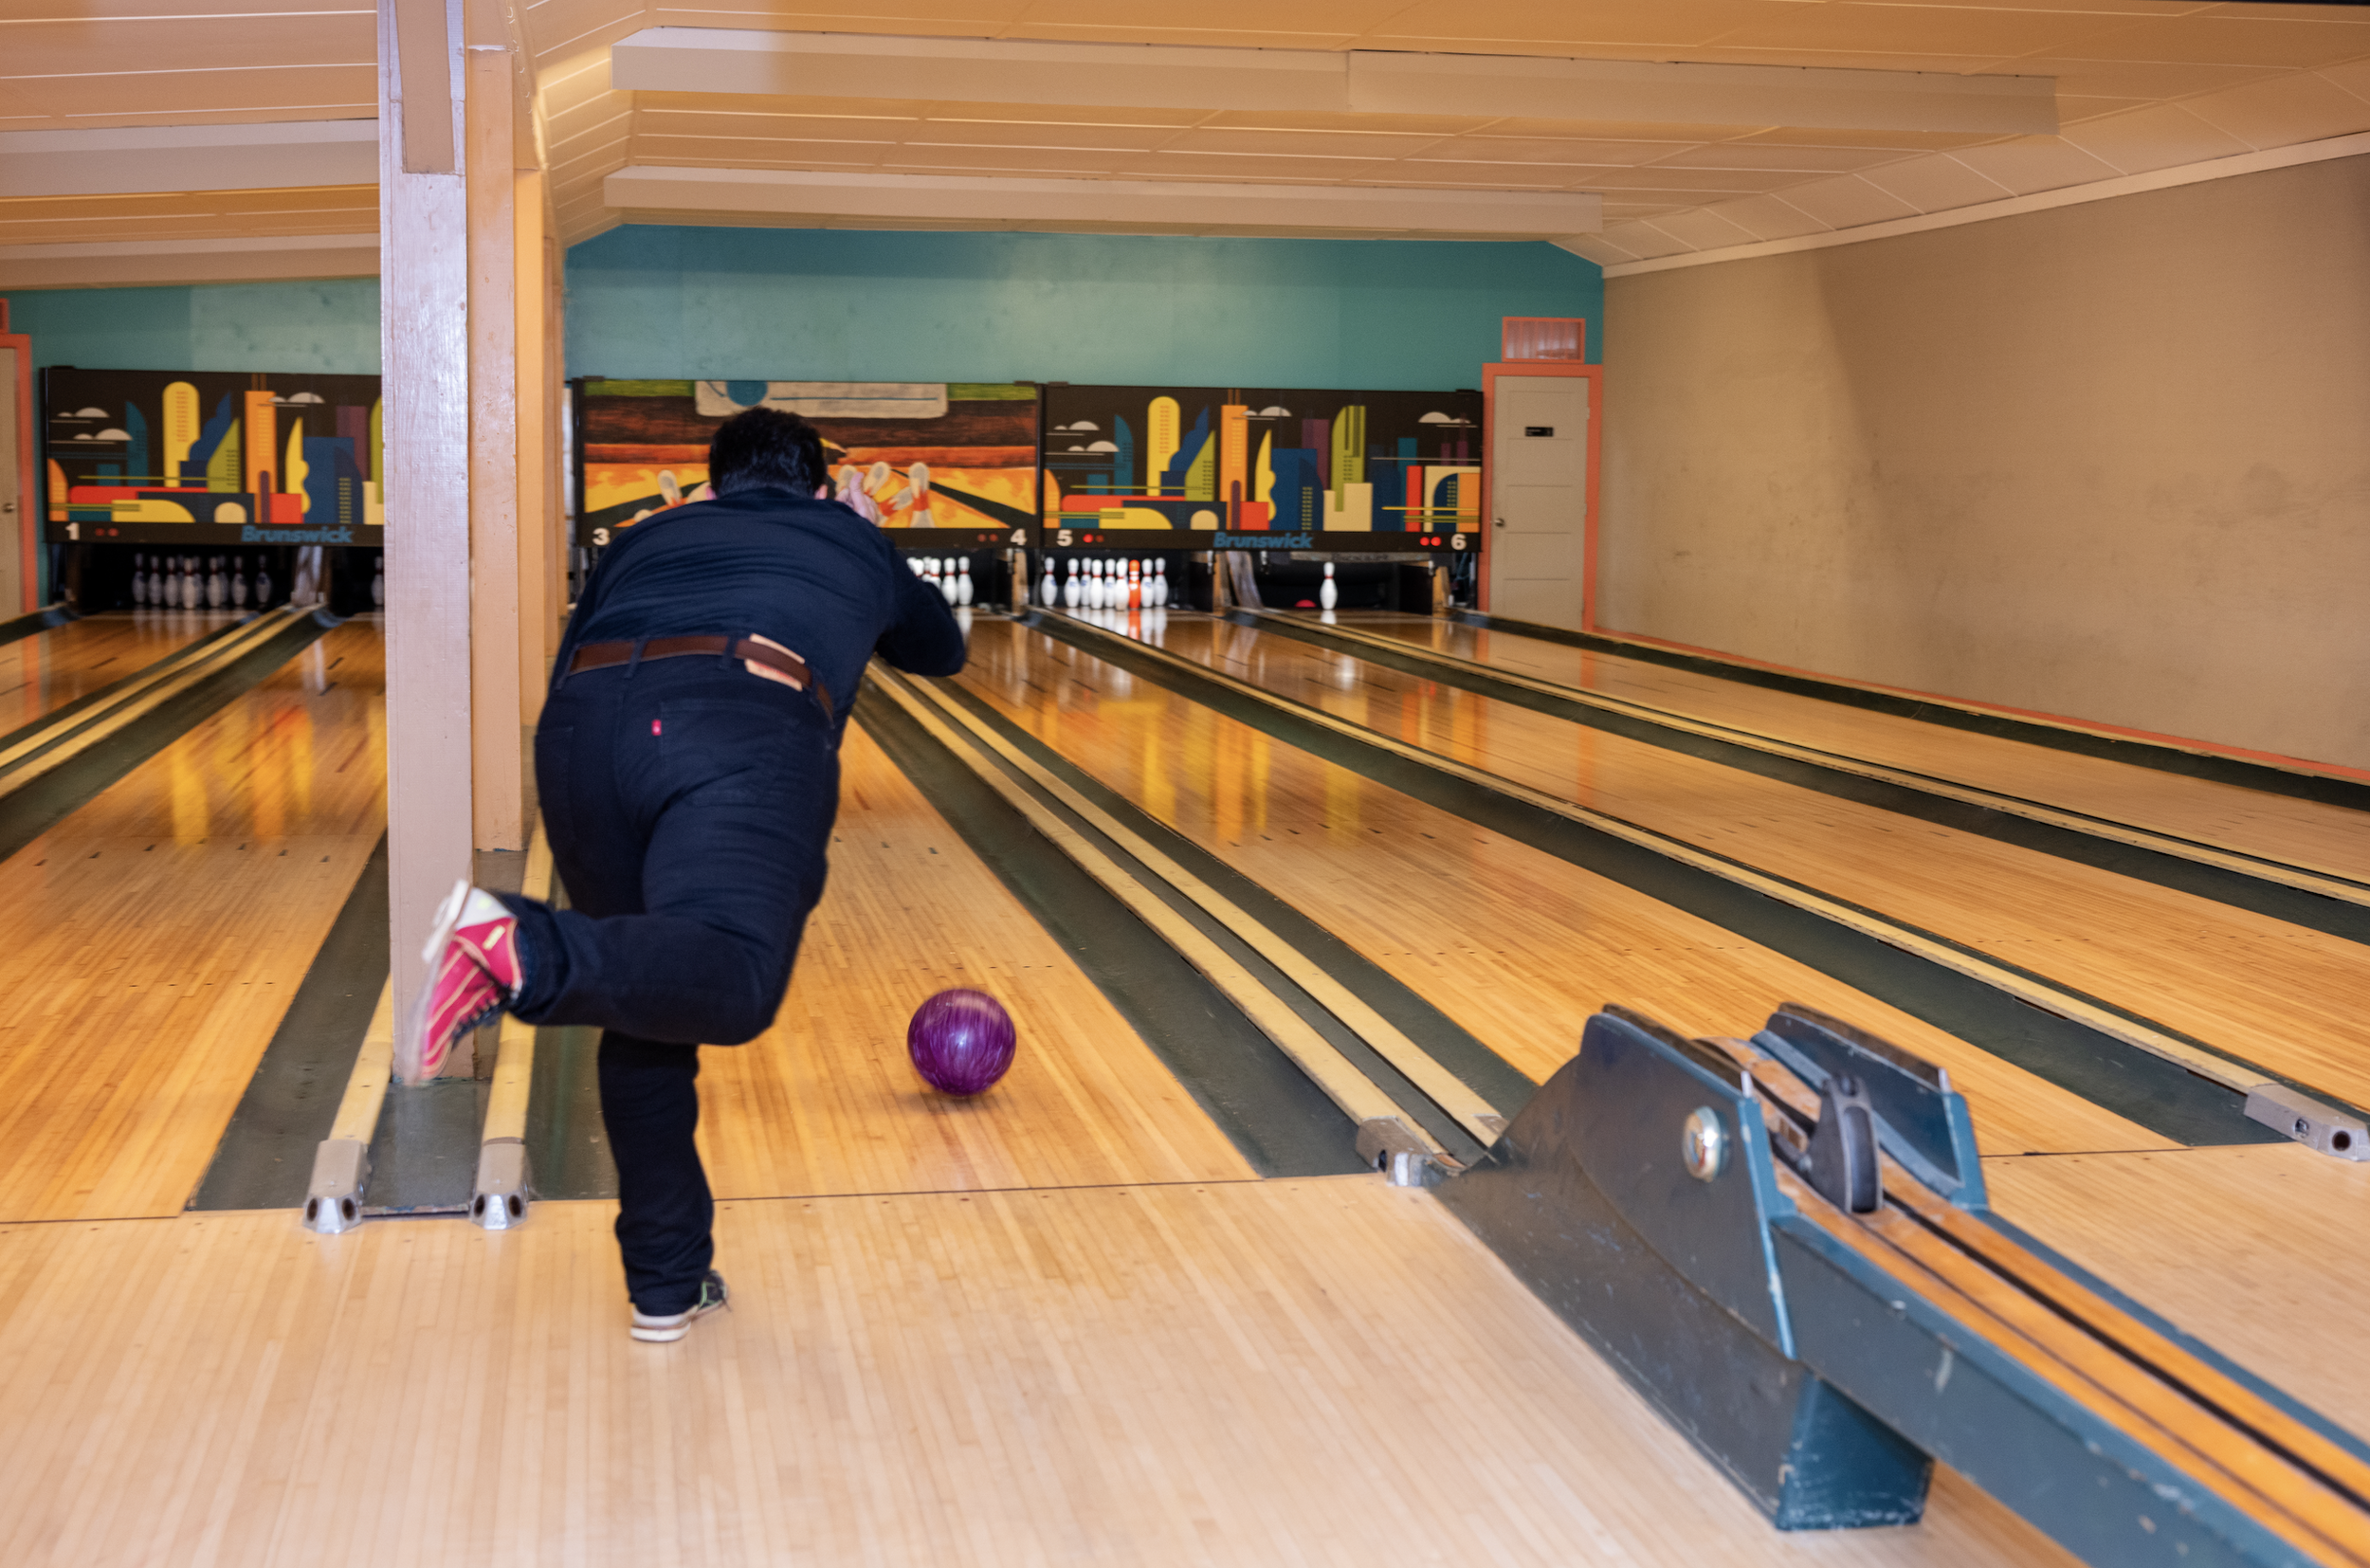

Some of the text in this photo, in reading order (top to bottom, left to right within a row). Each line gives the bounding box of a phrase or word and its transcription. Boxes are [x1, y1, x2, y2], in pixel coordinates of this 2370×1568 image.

[65, 522, 80, 540] 1
[241, 525, 353, 543] Brunswick
[592, 527, 611, 546] 3
[1010, 528, 1027, 546] 4
[1056, 529, 1073, 547] 5
[1213, 532, 1313, 549] Brunswick
[1450, 533, 1467, 550] 6
